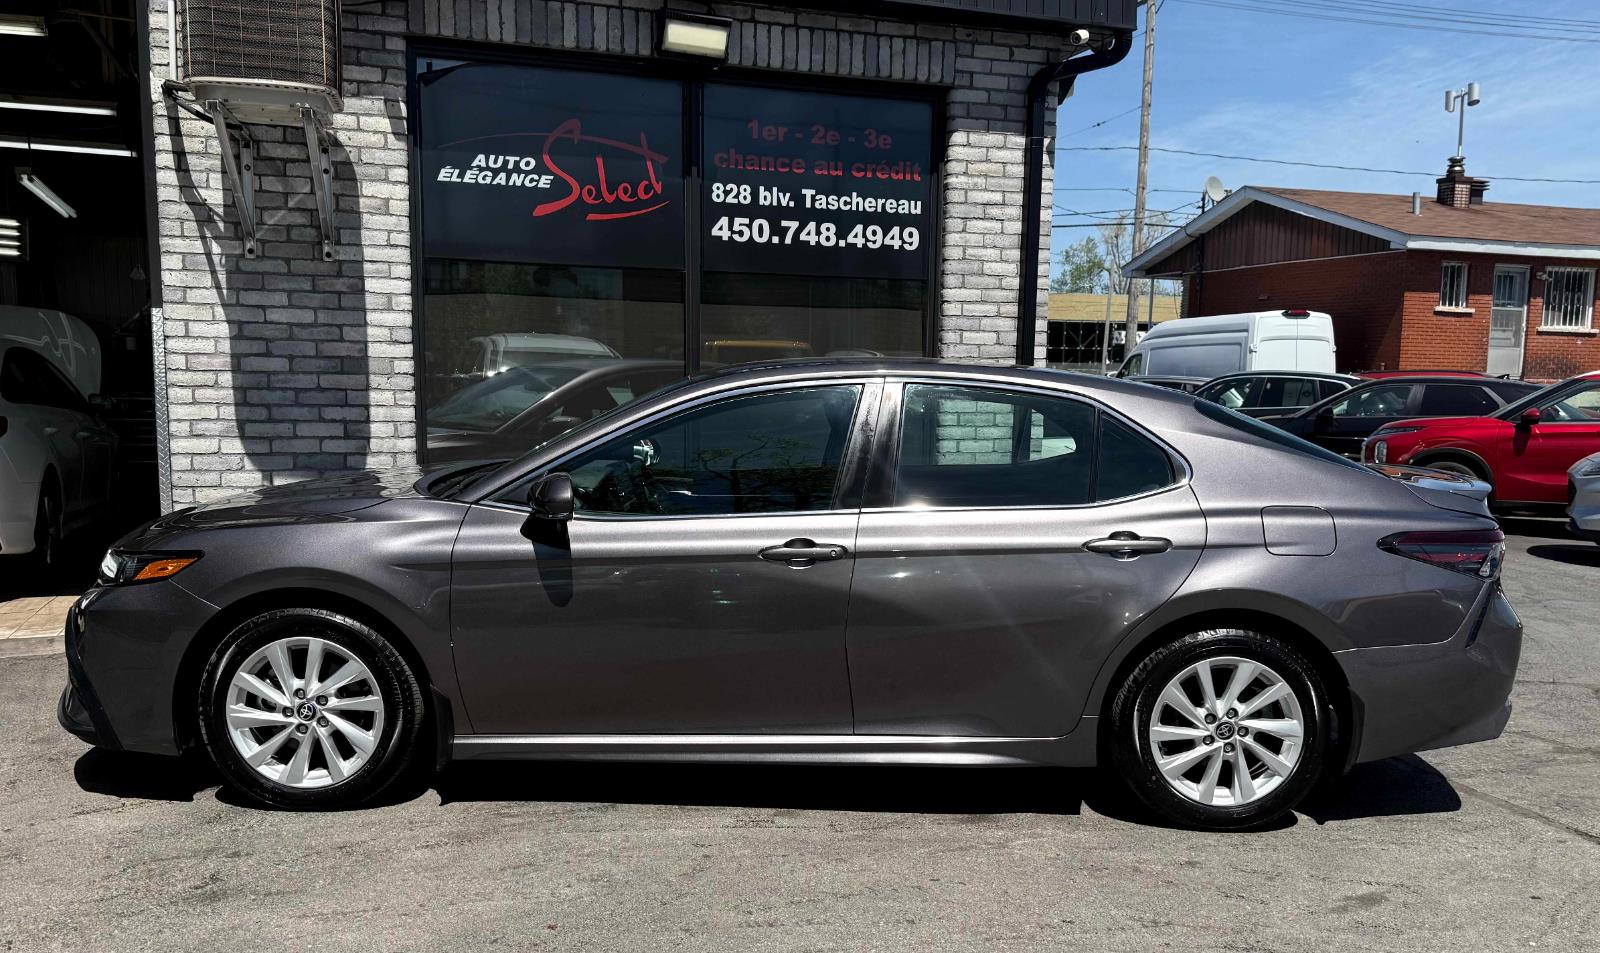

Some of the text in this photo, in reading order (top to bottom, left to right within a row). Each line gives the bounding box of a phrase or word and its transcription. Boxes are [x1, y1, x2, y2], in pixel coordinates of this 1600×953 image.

[747, 119, 789, 142] 1er
[811, 124, 841, 145] 2e
[864, 128, 892, 149] 3e
[437, 166, 554, 188] ÉLÉGANCE
[471, 153, 536, 171] AUTO
[533, 118, 668, 217] Select
[714, 148, 922, 182] chance au crédit
[711, 182, 922, 215] 828 blv. Taschereau
[711, 216, 920, 251] 450.748.4949
